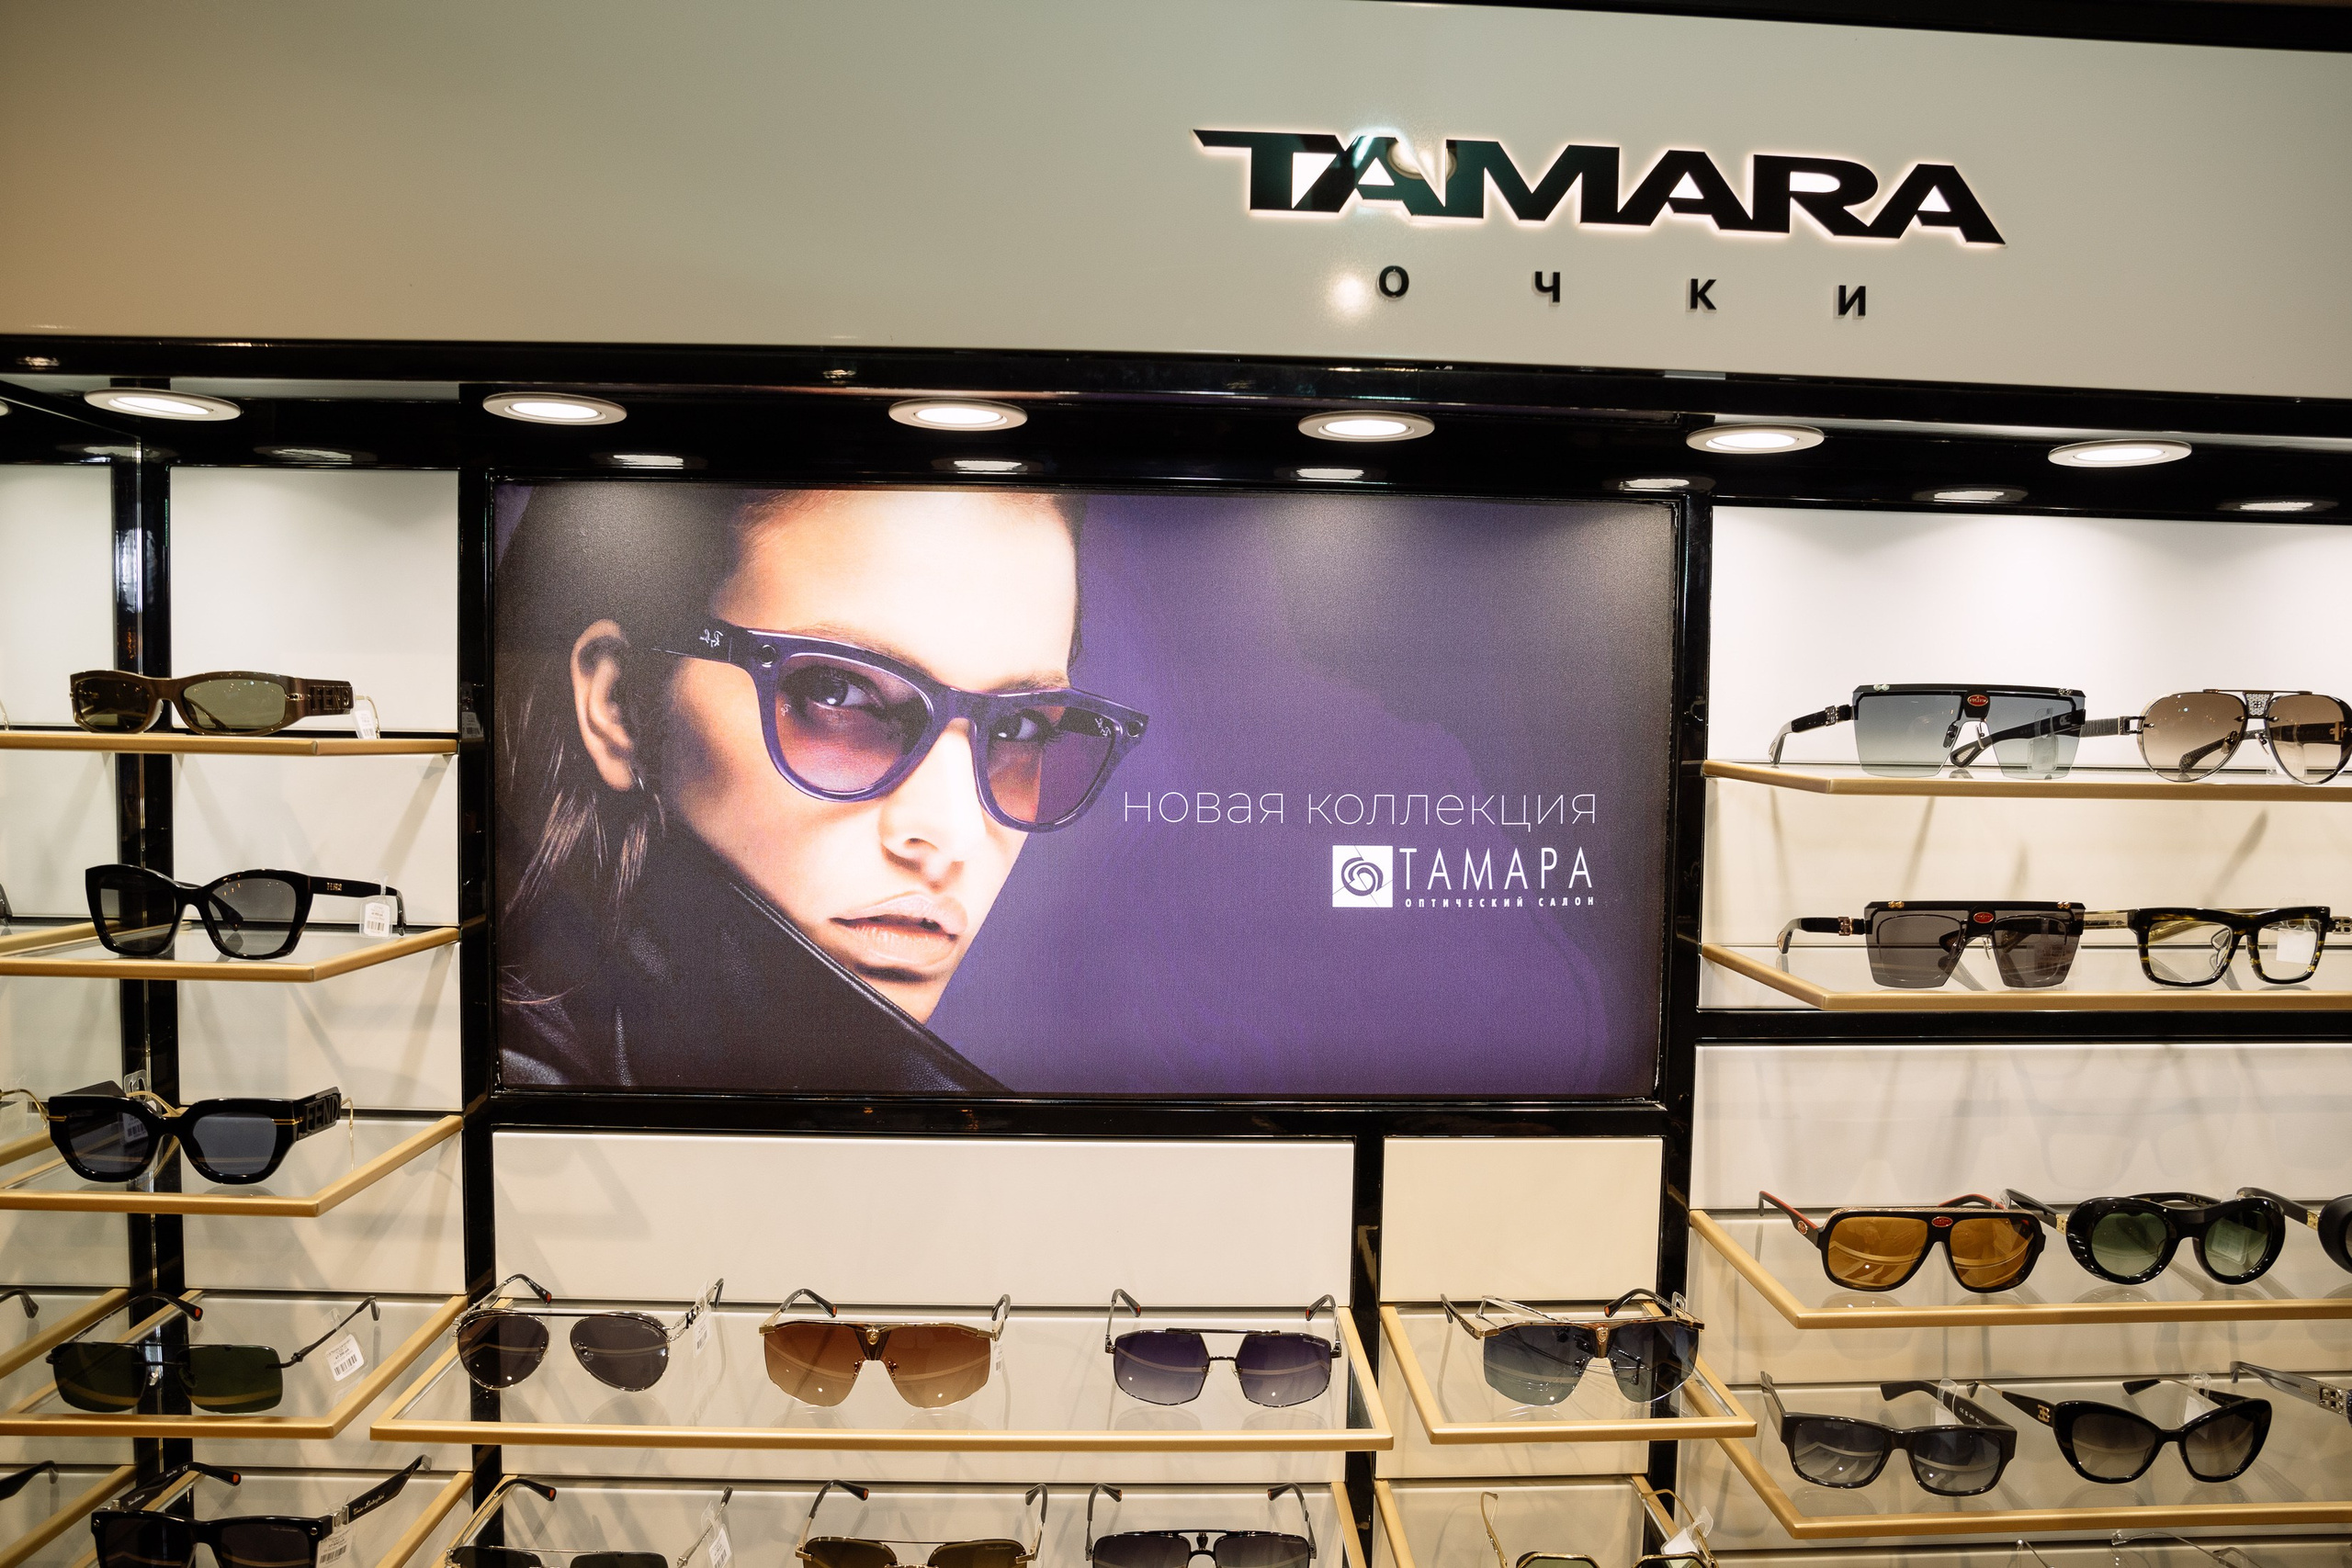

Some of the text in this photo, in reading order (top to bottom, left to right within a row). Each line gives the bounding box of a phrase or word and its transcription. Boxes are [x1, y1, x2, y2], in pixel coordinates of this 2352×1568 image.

[1193, 129, 2007, 246] TAMARA
[1124, 791, 1596, 832] новая коллекция
[1398, 846, 1593, 891] ТАМАРА
[1405, 896, 1594, 908] ОПТИЧЕСКИЙ САЛОН
